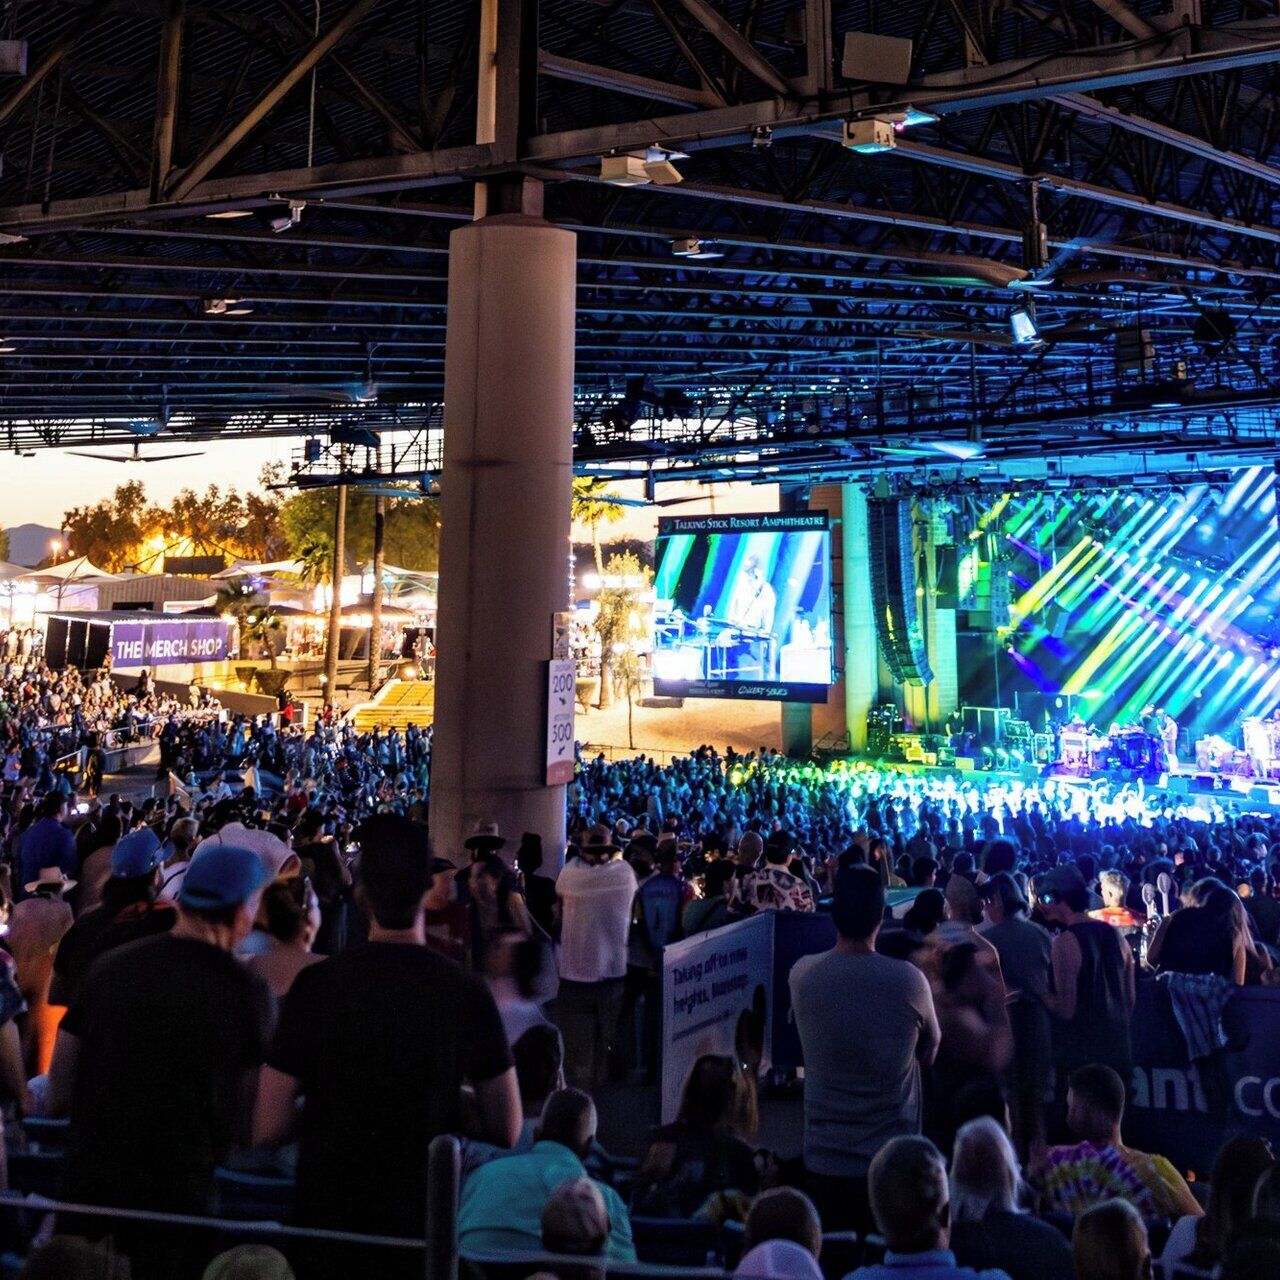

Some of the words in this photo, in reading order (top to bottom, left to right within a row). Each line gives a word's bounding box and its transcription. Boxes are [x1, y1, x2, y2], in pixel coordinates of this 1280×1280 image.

[674, 518, 706, 530] TALKING
[707, 517, 728, 529] STICK
[730, 516, 760, 528] RESORT
[762, 515, 824, 527] AMPHITHEATRE
[117, 640, 142, 659] THE
[145, 639, 188, 658] MERCH
[190, 637, 222, 656] SHOP
[552, 673, 573, 693] 200
[552, 723, 572, 743] 300
